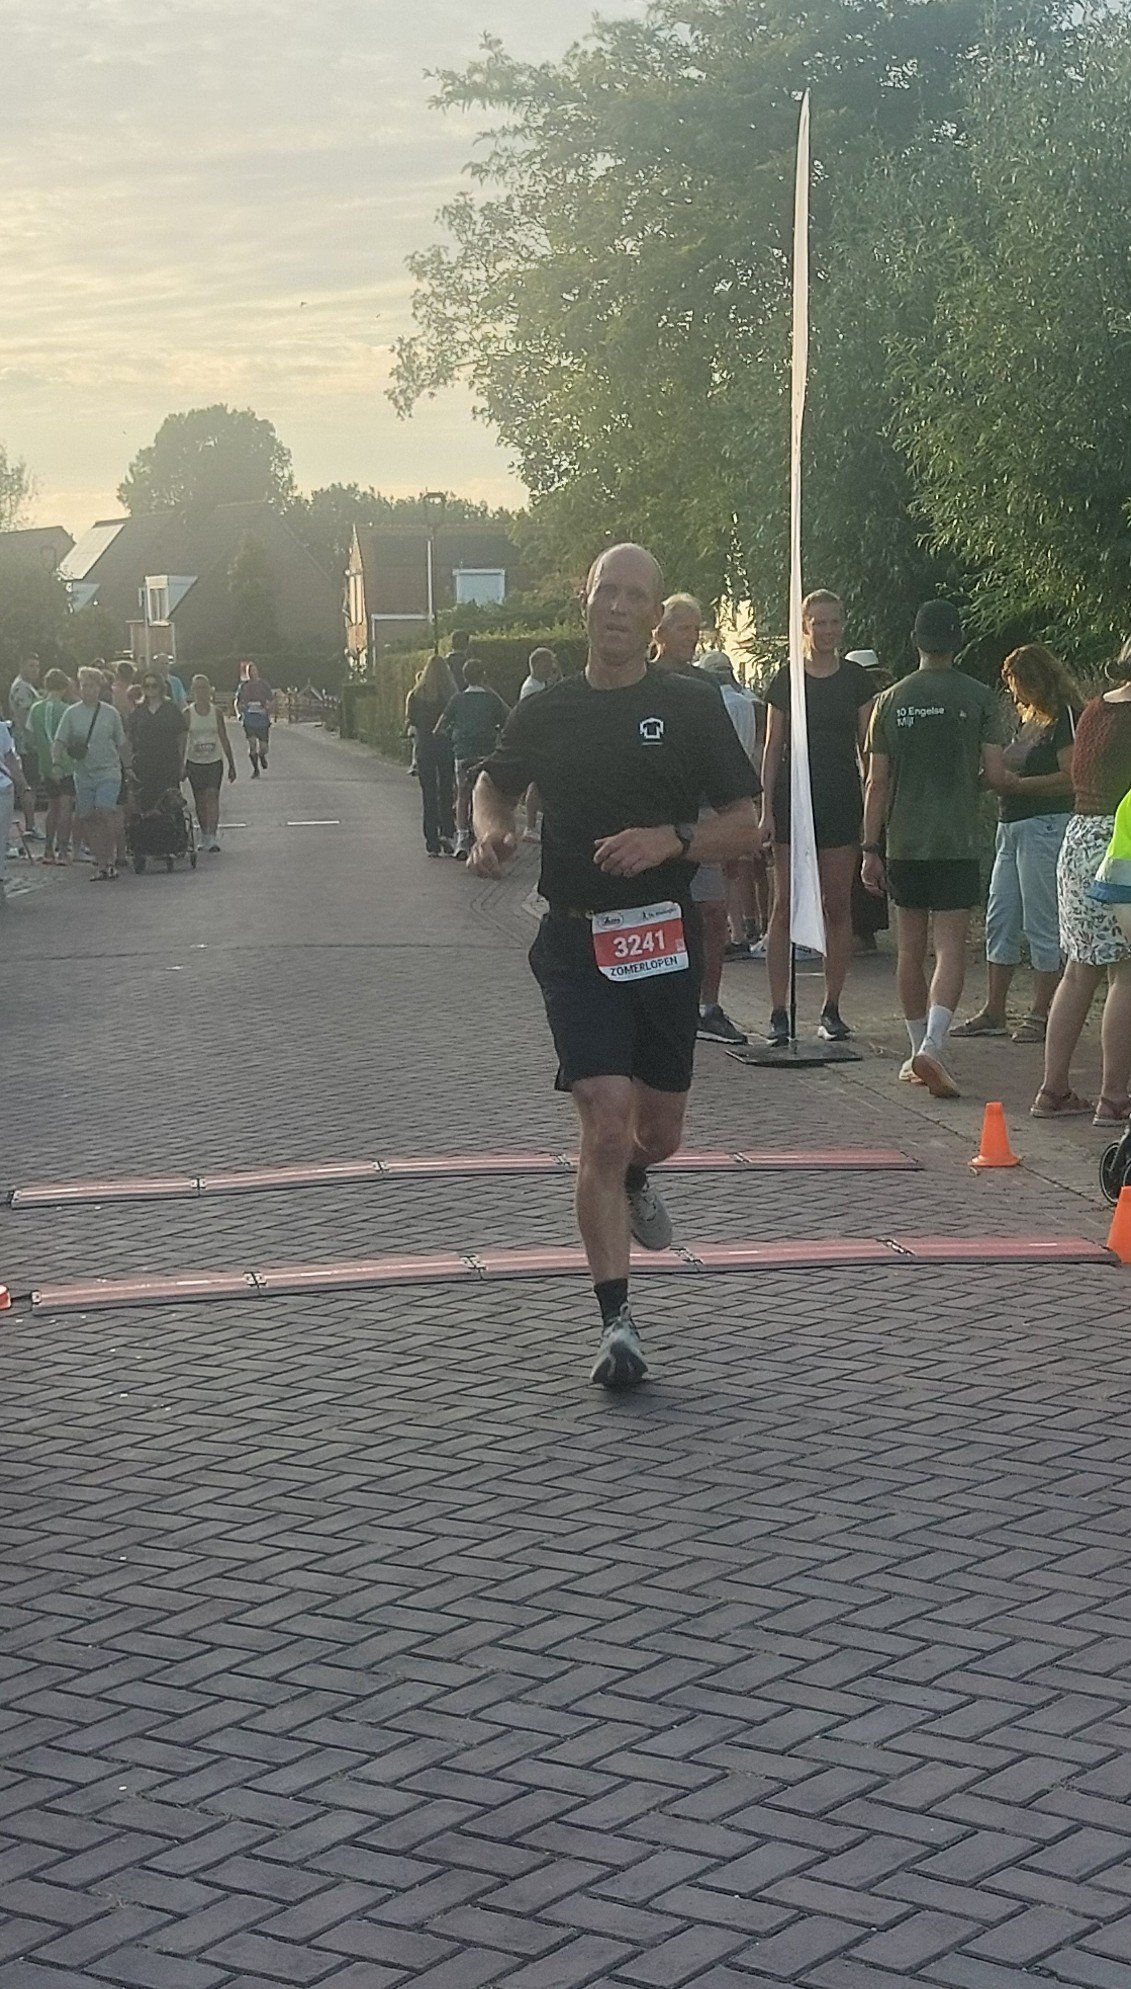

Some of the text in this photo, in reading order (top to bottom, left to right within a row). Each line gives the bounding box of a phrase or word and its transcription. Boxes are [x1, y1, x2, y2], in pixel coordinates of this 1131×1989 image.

[896, 706, 945, 718] 10 Engelse
[613, 930, 665, 958] 3241
[611, 957, 678, 977] ZOMERLOPEN
